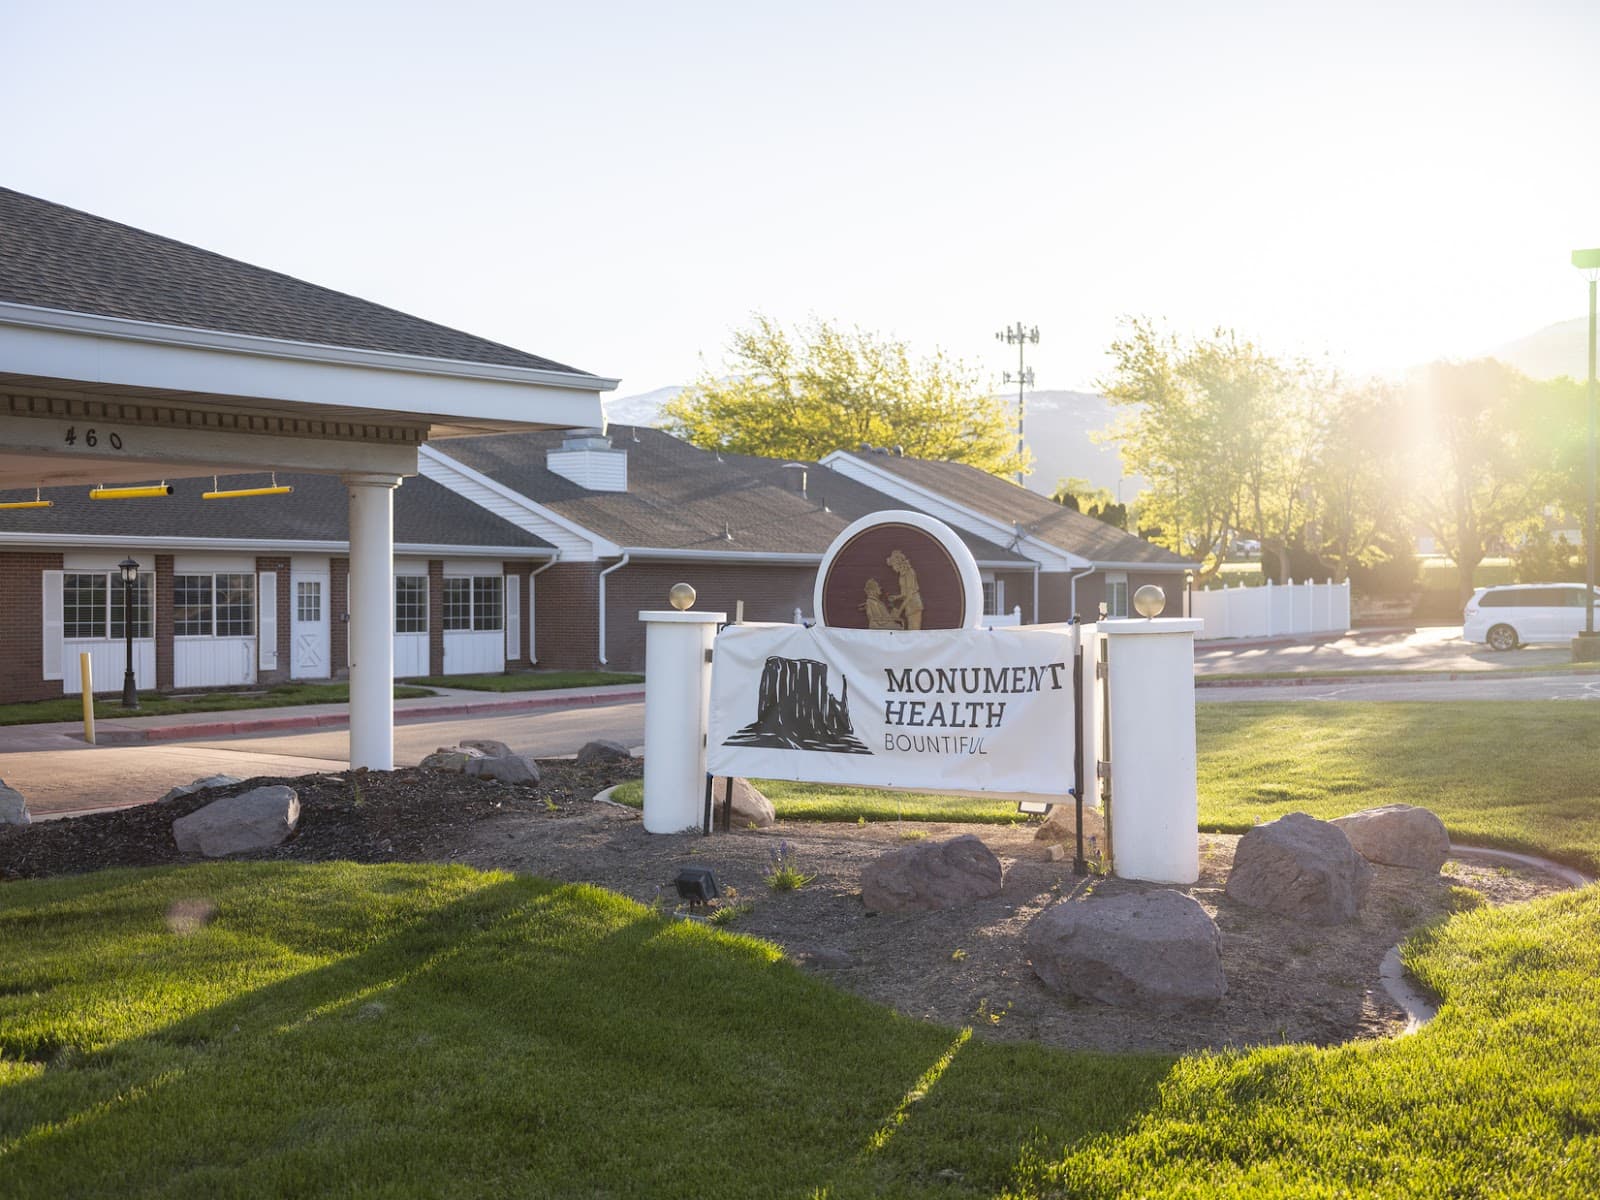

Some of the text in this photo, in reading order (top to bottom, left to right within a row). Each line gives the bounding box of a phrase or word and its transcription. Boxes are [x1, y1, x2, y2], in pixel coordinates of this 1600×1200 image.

[65, 426, 122, 450] 460
[884, 662, 1065, 693] MONUMENT
[884, 700, 1007, 728] HEALTH
[885, 733, 987, 755] BOUNTIFUL
